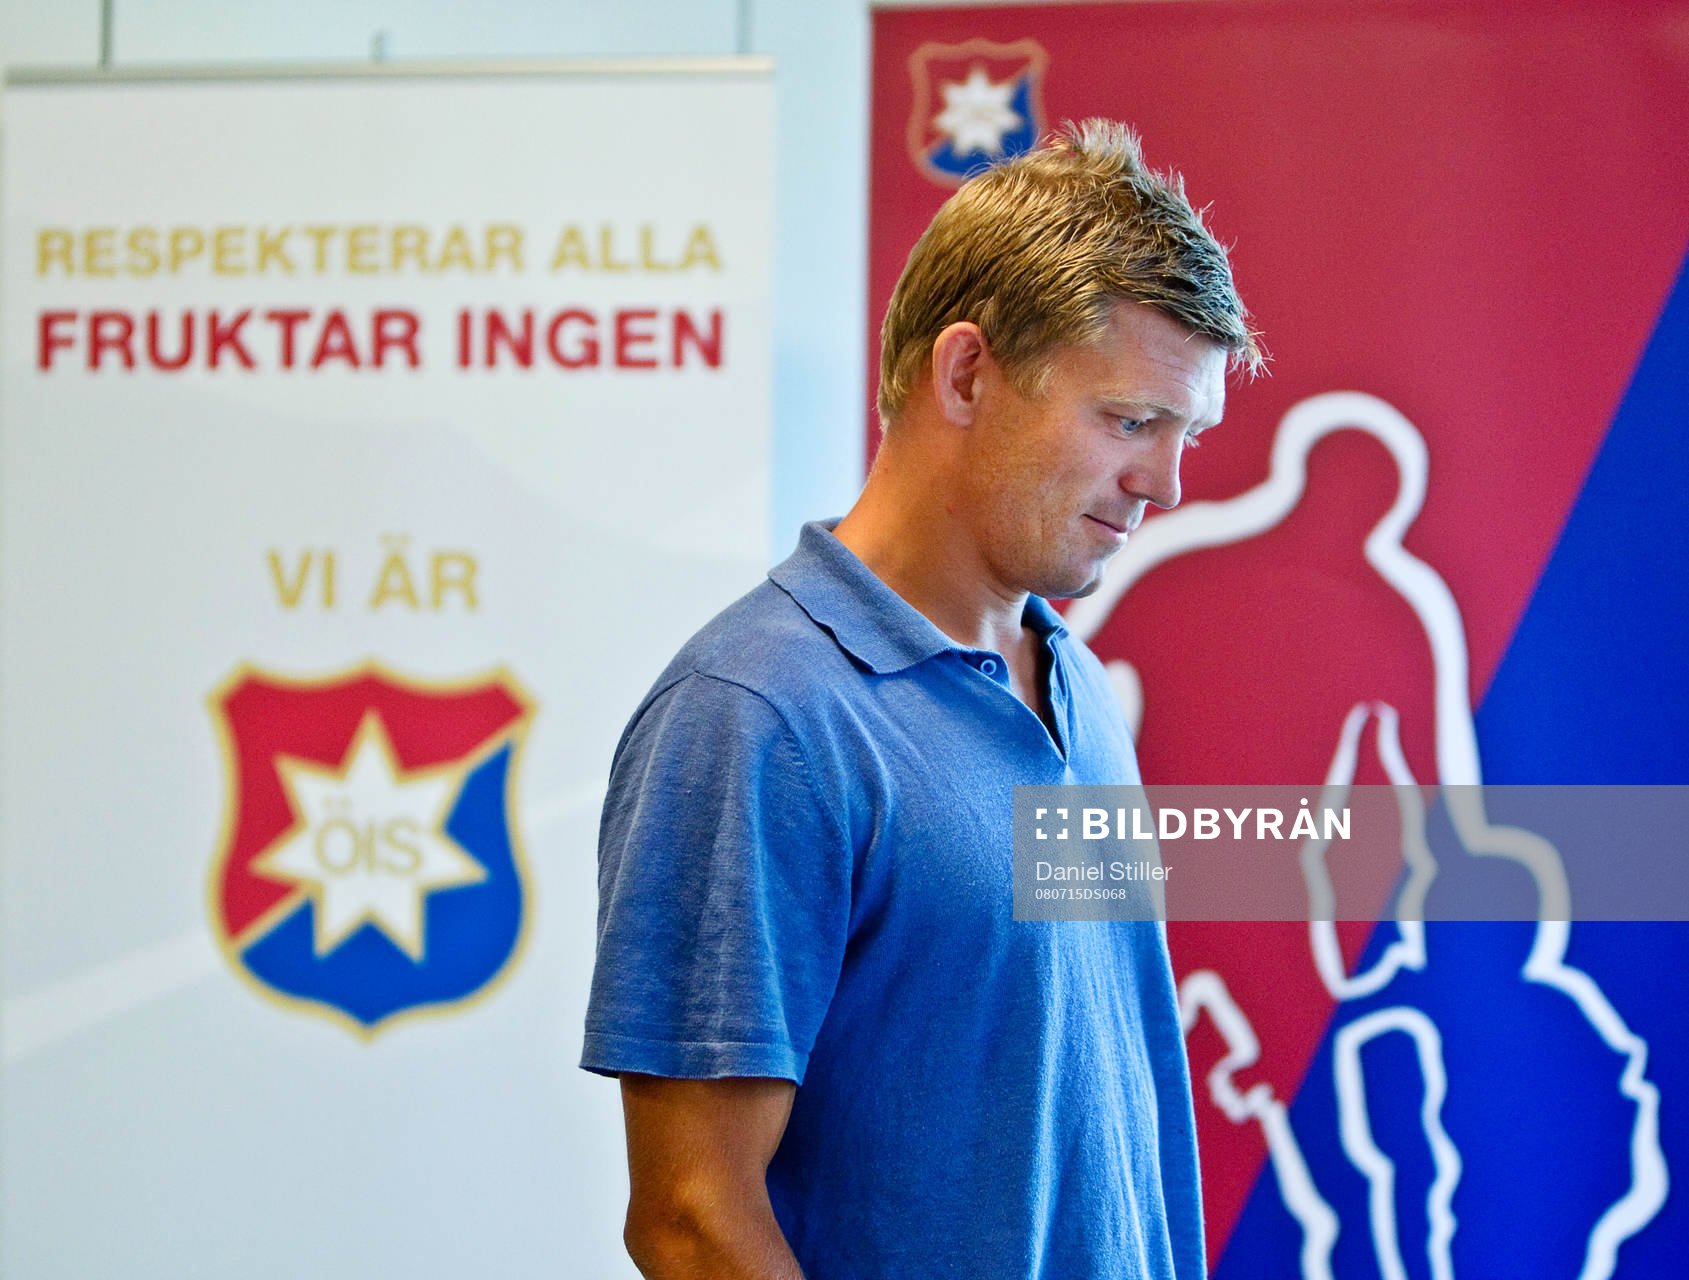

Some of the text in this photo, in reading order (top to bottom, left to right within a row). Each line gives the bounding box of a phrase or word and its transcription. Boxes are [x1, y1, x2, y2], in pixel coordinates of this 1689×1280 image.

[36, 224, 722, 278] RESPEKTERAR ALLA
[36, 307, 725, 373] FRUKTAR INGEN
[267, 533, 479, 610] VI ÄR
[314, 795, 424, 877] ÖIS
